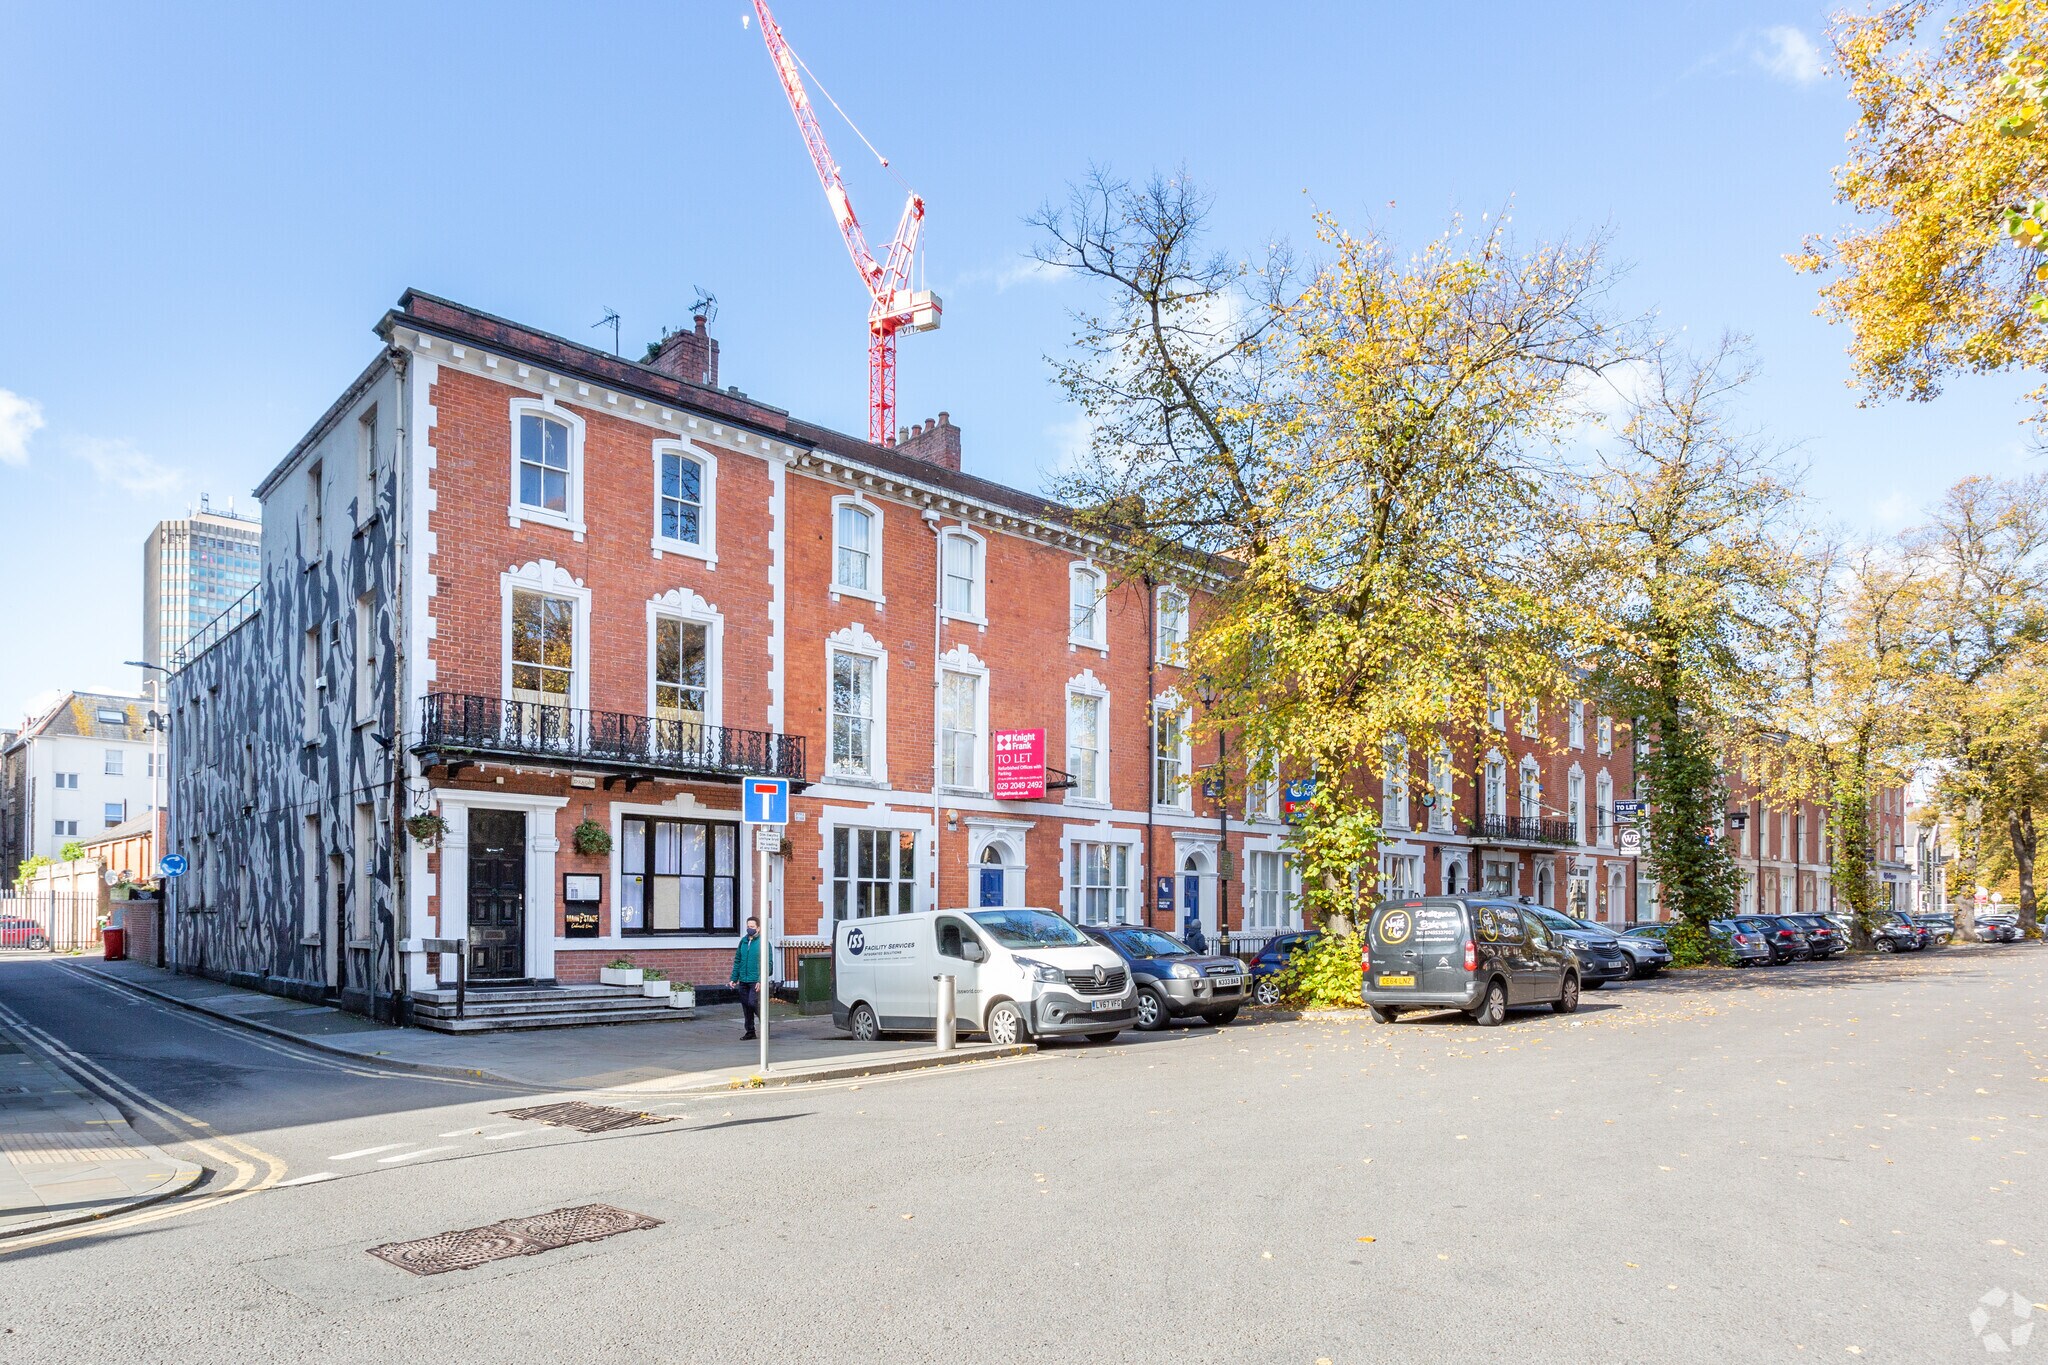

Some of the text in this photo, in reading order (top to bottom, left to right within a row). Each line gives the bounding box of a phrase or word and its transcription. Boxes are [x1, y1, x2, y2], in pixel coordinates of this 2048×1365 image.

[1012, 733, 1036, 743] Knight
[1012, 742, 1032, 750] Frank
[996, 753, 1033, 764] TO LET
[1027, 781, 1043, 789] 2492
[583, 914, 599, 922] STAGE
[1095, 1000, 1110, 1009] LV67
